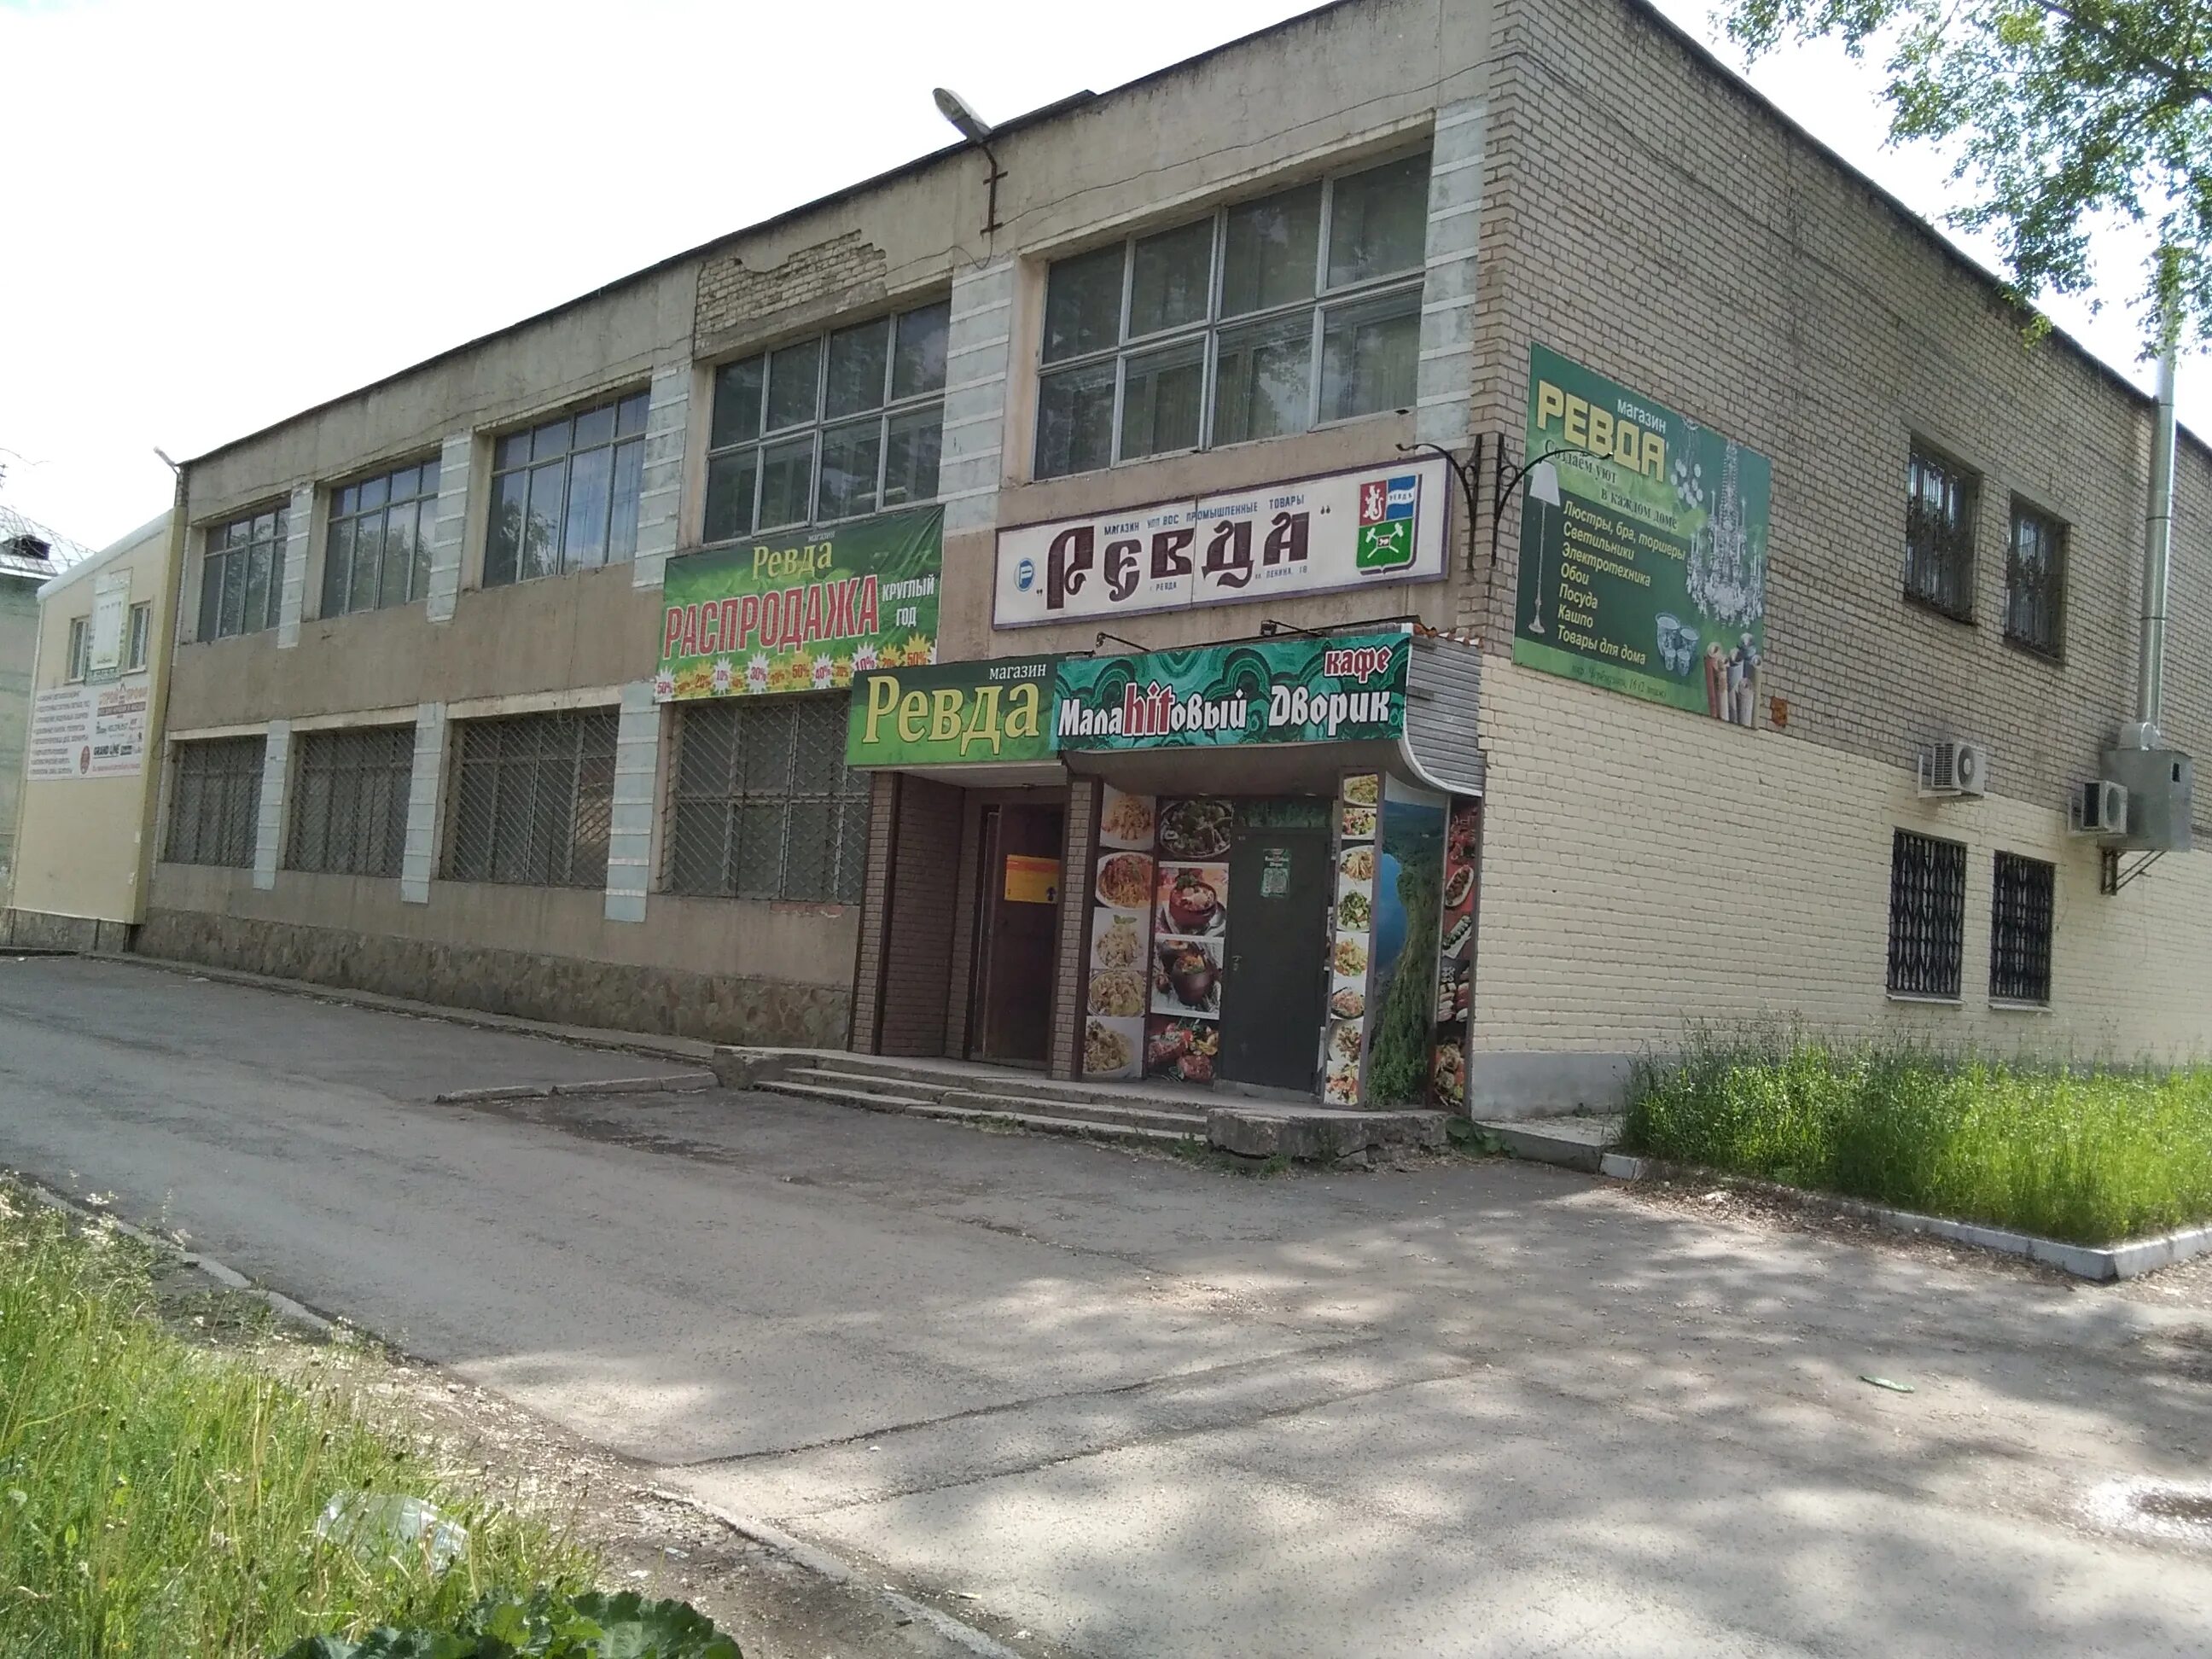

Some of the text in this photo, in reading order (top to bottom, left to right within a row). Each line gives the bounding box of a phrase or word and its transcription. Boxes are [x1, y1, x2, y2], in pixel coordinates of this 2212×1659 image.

[1537, 380, 1666, 483] РЕВДА
[1617, 399, 1667, 434] магазин
[1595, 464, 1617, 485] уют
[1103, 521, 1140, 536] МАГАЗИН
[1162, 514, 1180, 526] ВОС
[1185, 501, 1259, 523] ПРОМЫШЛЕННЫЕ
[1268, 494, 1305, 510] ТОВАРЫ
[1600, 487, 1679, 530] в каждом доме
[1563, 499, 1687, 562] Люстры, бра, торшеры
[1563, 521, 1635, 561] Светильники
[752, 541, 833, 582] Ревда
[1560, 562, 1590, 586] Обои
[1561, 542, 1652, 587] Электротехника
[882, 573, 935, 602] КРУГЛЫЙ
[1155, 580, 1178, 592] РЕВДА
[1558, 582, 1598, 610] Посуда
[663, 573, 880, 660] РАСПРОДАЖА
[896, 606, 917, 628] ГОД
[1557, 603, 1594, 629] Кашпо
[906, 650, 928, 667] 50%
[1557, 625, 1646, 666] Товары для дома
[750, 666, 767, 682] 30%
[792, 662, 810, 680] 50%
[814, 665, 831, 681] 40%
[988, 663, 1047, 681] магазин
[1324, 646, 1393, 684] кафе
[656, 681, 673, 695] 50%
[862, 675, 1040, 757] Ревда
[1057, 679, 1391, 738] Малаhitовый Дворик
